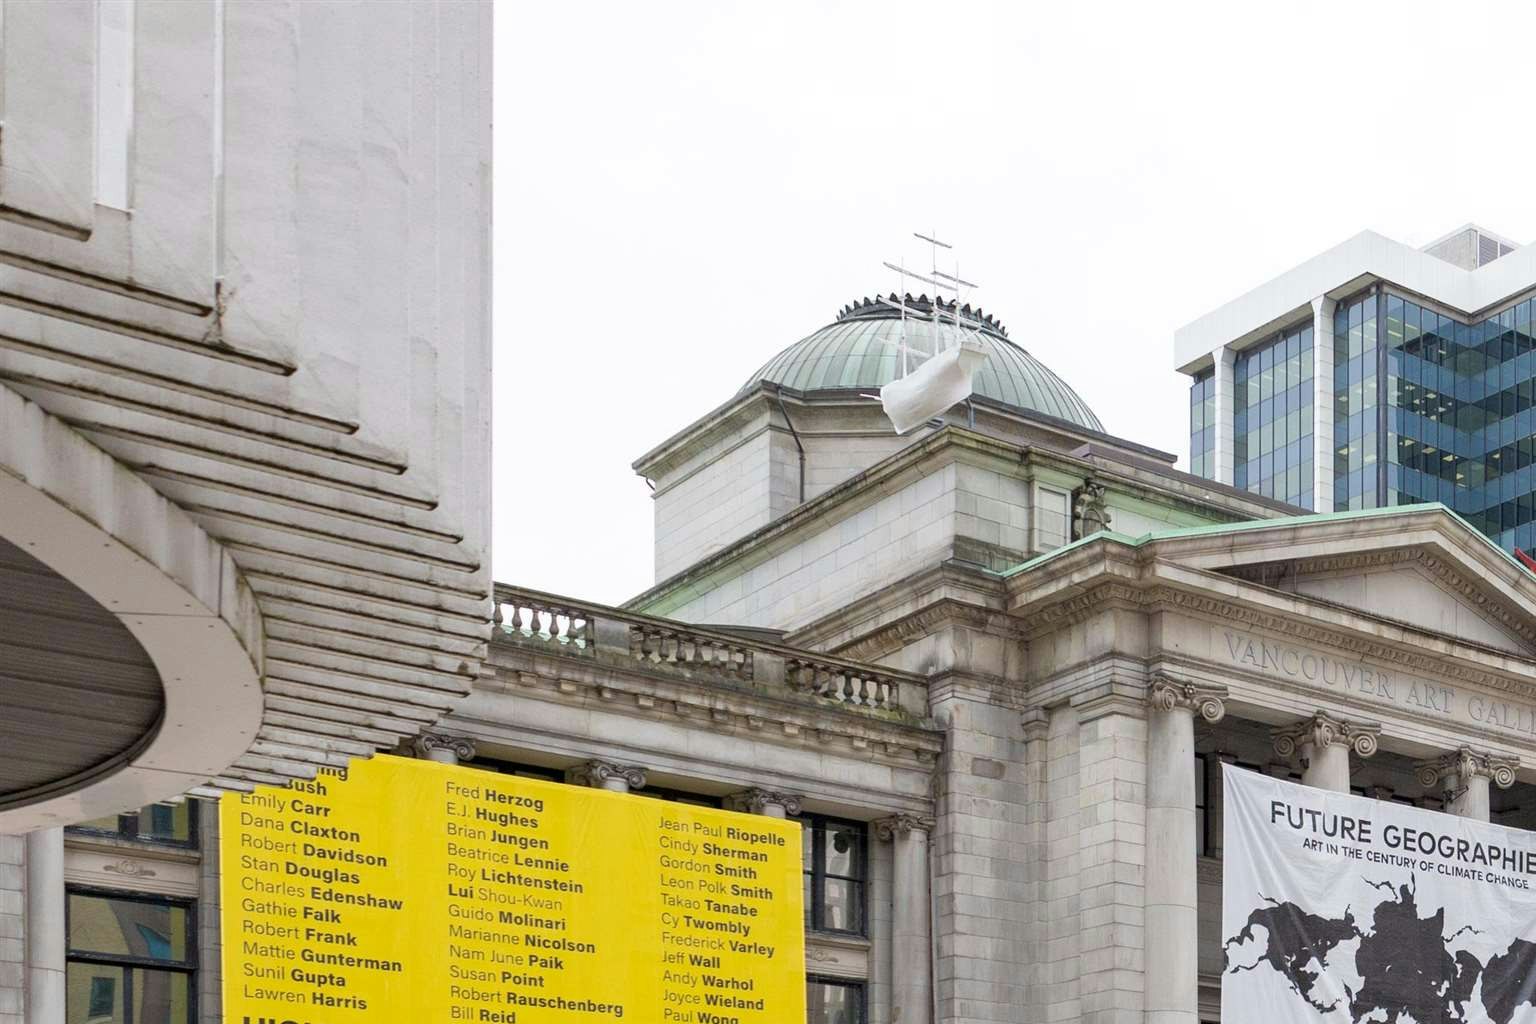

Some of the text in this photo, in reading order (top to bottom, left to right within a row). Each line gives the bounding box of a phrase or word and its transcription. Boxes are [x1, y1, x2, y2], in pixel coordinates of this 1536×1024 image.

[1224, 631, 1392, 699] VANCOUVER
[1407, 684, 1455, 714] ART
[241, 794, 331, 817] Emily Carr
[446, 781, 544, 812] Fred Herzog
[240, 812, 360, 842] Dana Claxton
[447, 802, 539, 828] E.J. Hughes
[1271, 800, 1372, 843] FUTURE
[447, 823, 549, 850] Brian Jungen
[658, 817, 785, 846] Jean Paul Riopelle
[241, 834, 387, 867] Robert Davidson
[447, 842, 569, 872] Beatrice Lennie
[659, 836, 768, 862] Cindy Sherman
[241, 855, 360, 884] Stan Douglas
[660, 855, 757, 879] Gordon Smith
[1303, 838, 1529, 889] ART IN THE CENTURY OF CLIMATE CHANGE
[448, 863, 583, 893] Roy Lichtenstein
[660, 874, 773, 900] Leon Polk Smith
[241, 877, 403, 910] Charles Edenshaw
[448, 884, 562, 911] Lui Shou-Kwan
[660, 892, 758, 917] Takao Tanabe
[242, 898, 341, 924] Gathie Falk
[449, 904, 566, 931] Guido Molinari
[243, 920, 357, 946] Robert Frank
[661, 912, 751, 937] Cy Twombly
[449, 924, 595, 953] Marianne Nicolson
[662, 932, 775, 959] Frederick Varley
[243, 941, 402, 971] Mattie Gunterman
[450, 945, 564, 970] Nam June Paik
[662, 951, 721, 969] Jeff Wall
[243, 963, 346, 987] Sunil Gupta
[449, 965, 544, 988] Susan Point
[663, 970, 754, 991] Andy Warhol
[244, 984, 367, 1009] Lawren Harris
[451, 986, 624, 1017] Robert Rauschenberg
[663, 989, 765, 1011] Joyce Wieland
[451, 1006, 516, 1024] Bill Reid
[664, 1008, 693, 1023] Paul
